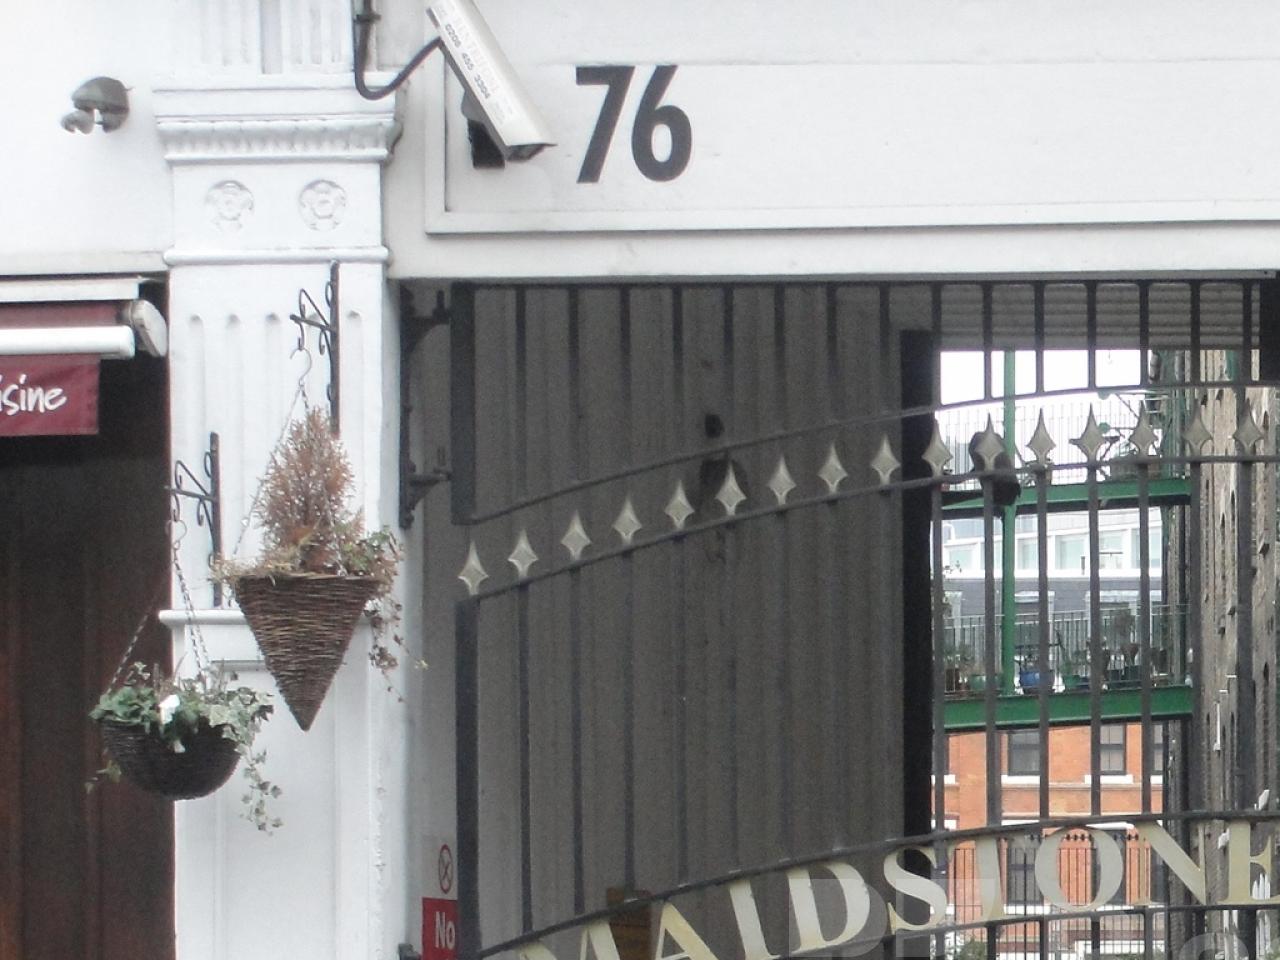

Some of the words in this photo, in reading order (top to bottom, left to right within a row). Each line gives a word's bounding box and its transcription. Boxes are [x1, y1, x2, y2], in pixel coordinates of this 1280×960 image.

[576, 65, 692, 184] 76
[0, 373, 68, 416] sine
[434, 911, 456, 950] No
